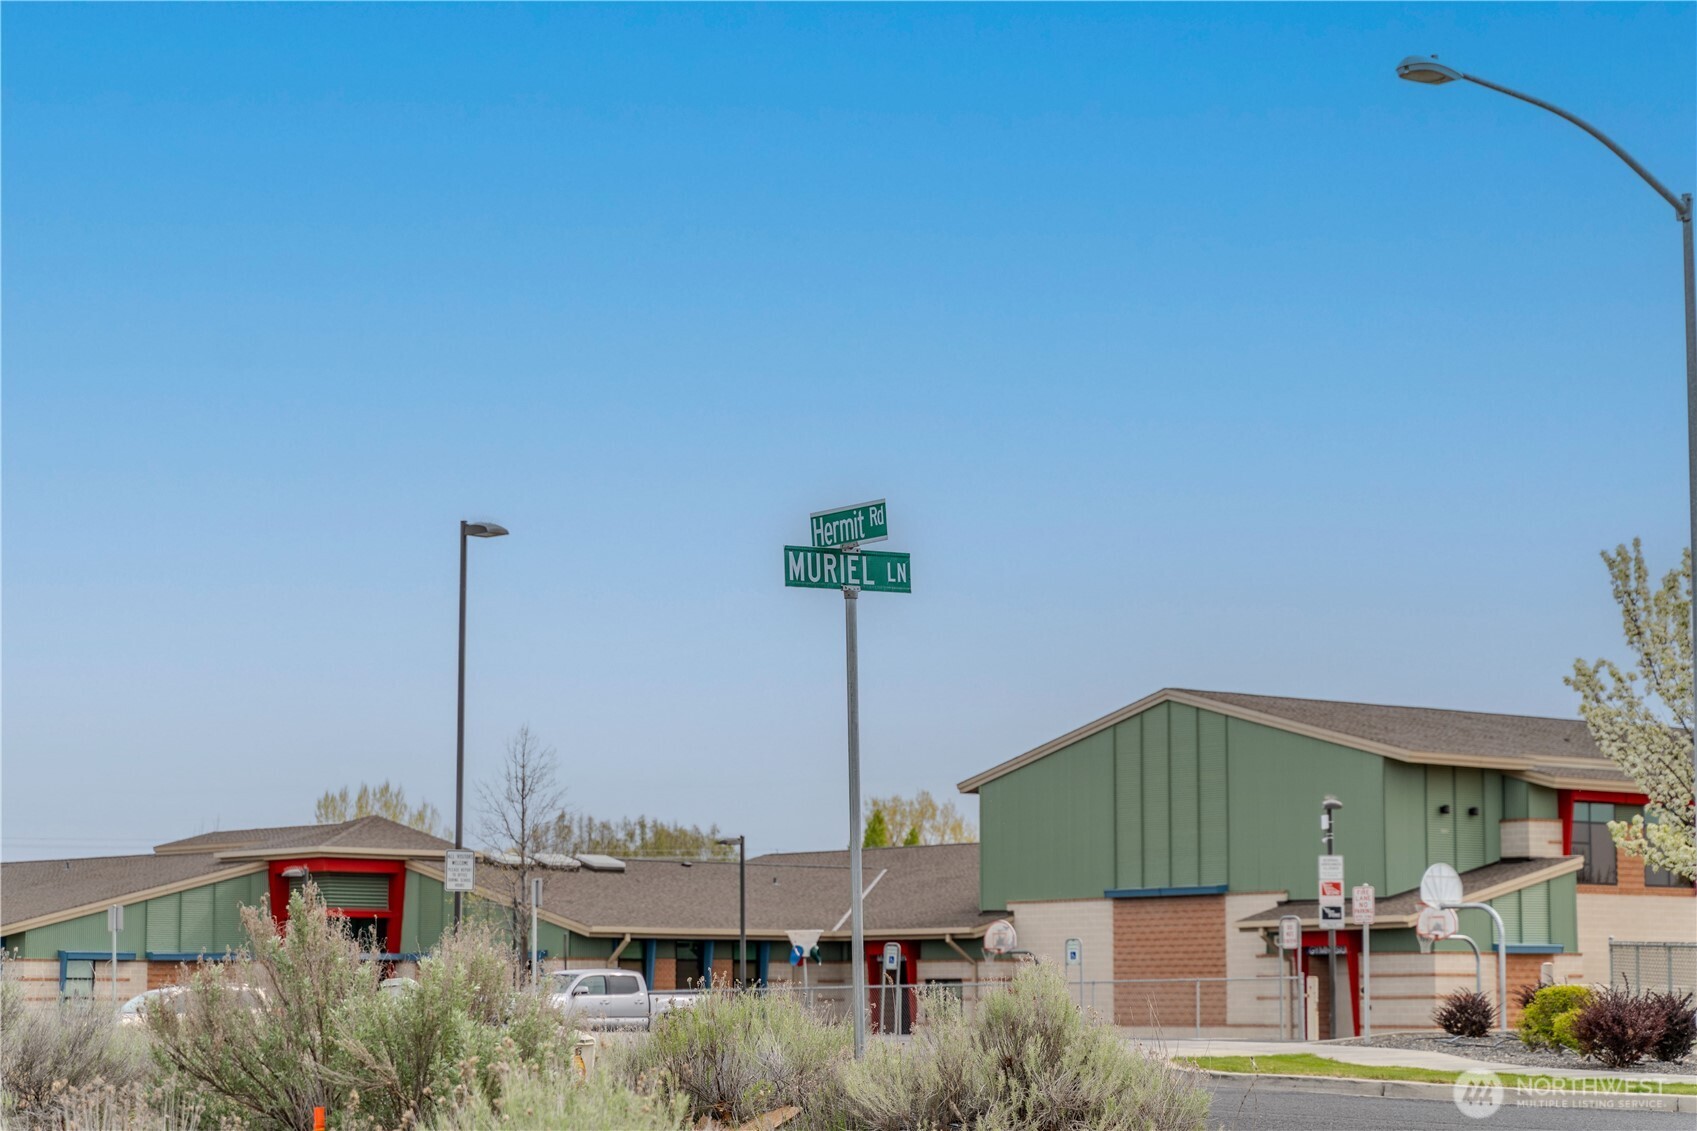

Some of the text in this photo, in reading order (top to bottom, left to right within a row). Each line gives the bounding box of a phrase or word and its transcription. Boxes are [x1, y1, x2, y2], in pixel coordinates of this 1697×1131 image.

[813, 505, 884, 546] Hermit Rd
[788, 551, 907, 585] MURIEL LN
